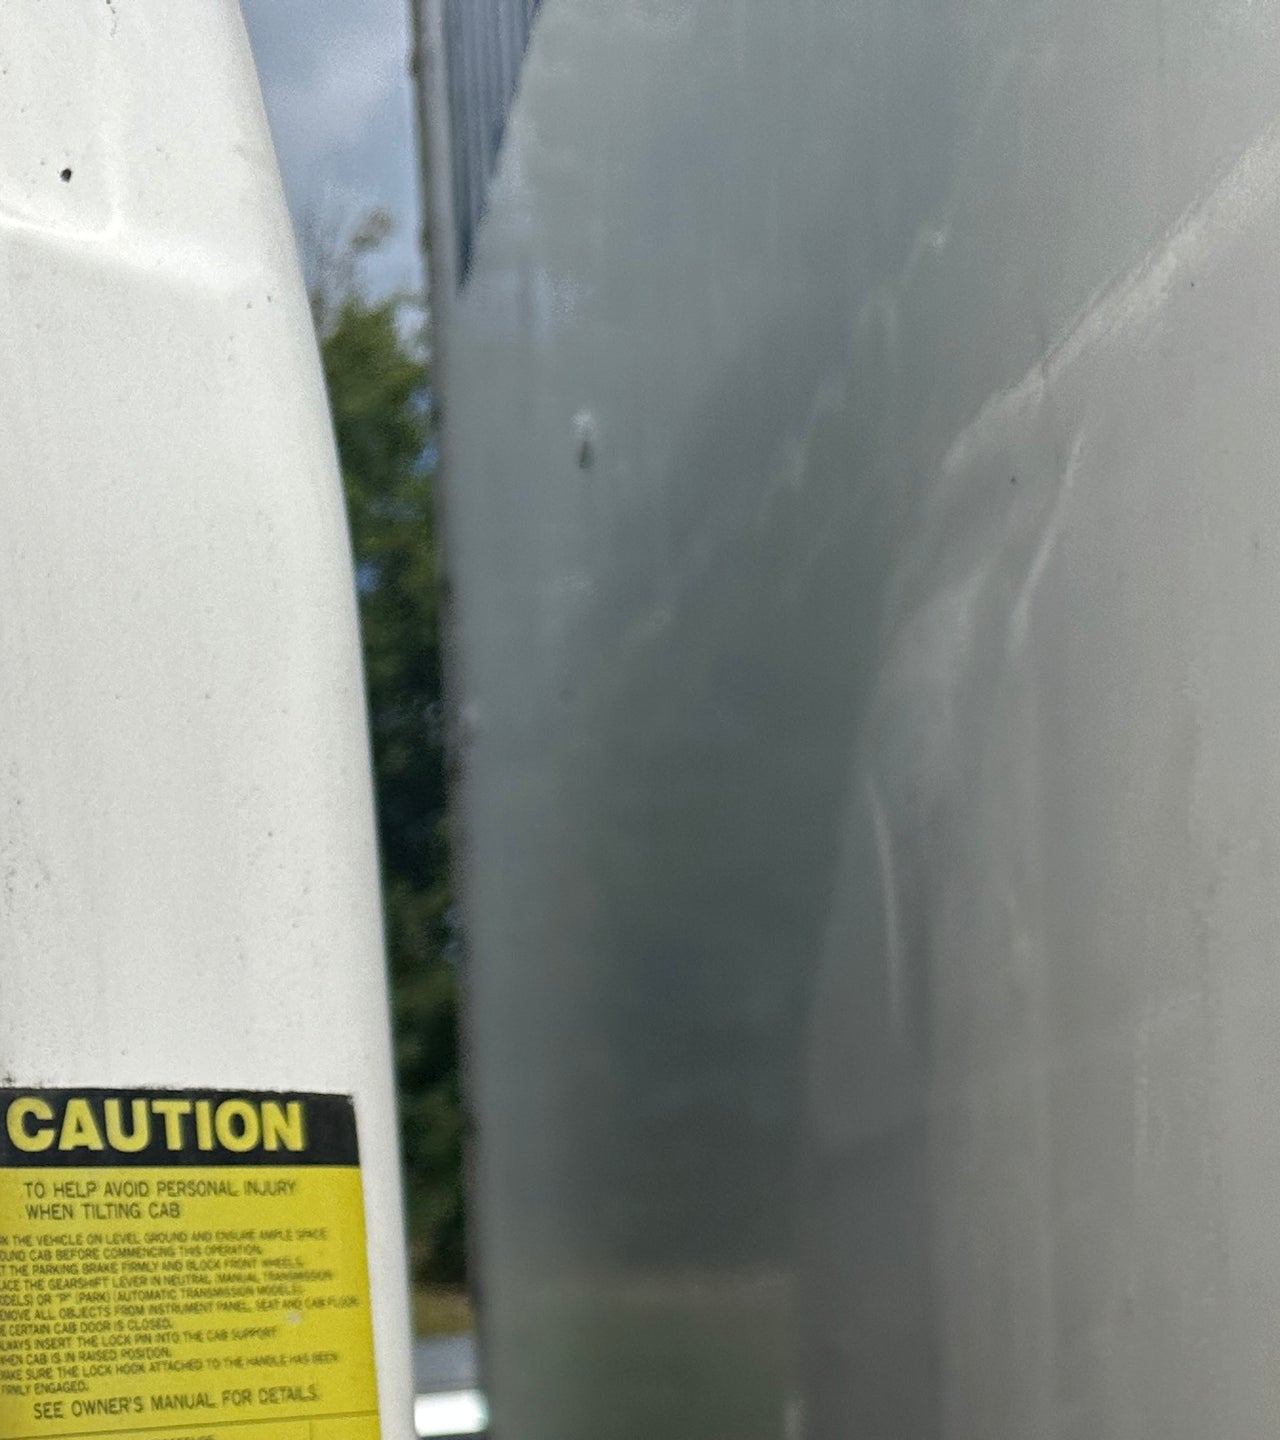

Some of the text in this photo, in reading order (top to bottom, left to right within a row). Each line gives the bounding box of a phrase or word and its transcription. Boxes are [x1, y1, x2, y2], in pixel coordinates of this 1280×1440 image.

[6, 1096, 308, 1153] CAUTION
[23, 1178, 297, 1199] TO HELP AVOID PERSONAL INJURY
[25, 1201, 181, 1220] WHEN TILTING CAB
[13, 1233, 33, 1247] THE
[36, 1232, 83, 1246] VEHICLE
[87, 1232, 102, 1246] ON
[105, 1231, 140, 1245] LEVEL
[144, 1230, 188, 1244] GROUND
[191, 1230, 213, 1243] AND
[29, 1248, 52, 1262] CAB
[55, 1247, 100, 1261] BEFORE
[103, 1246, 176, 1260] COMMENCING
[9, 1264, 29, 1277] THE
[32, 1262, 80, 1276] PARKING
[82, 1261, 119, 1275] BRAKE
[121, 1260, 159, 1274] FIRMLY
[162, 1259, 184, 1273] AND
[186, 1258, 221, 1272] BLOCK
[23, 1279, 45, 1292] THE
[48, 1276, 110, 1291] GEARSHIFT
[111, 1275, 148, 1289] LEVER
[151, 1275, 161, 1288] IN
[163, 1273, 211, 1287] NEUTRAL
[36, 1293, 52, 1307] OR
[180, 1284, 256, 1300] TRANSMISSION
[34, 1308, 56, 1322] ALL
[59, 1305, 111, 1320] OBJECTS
[114, 1304, 145, 1317] FROM
[147, 1301, 214, 1316] INSTRUMENT
[9, 1322, 51, 1337] CERTAIN
[53, 1321, 77, 1335] CAB
[79, 1319, 112, 1334] DOOR
[114, 1319, 125, 1332] IS
[34, 1336, 73, 1351] INSERT
[77, 1334, 99, 1349] THE
[101, 1333, 132, 1348] LOCK
[134, 1332, 153, 1345] PIN
[154, 1331, 180, 1344] INTO
[182, 1330, 204, 1343] THE
[206, 1328, 229, 1342] CAB
[0, 1353, 24, 1367] WHEN
[26, 1352, 49, 1366] CAB
[51, 1351, 62, 1364] IS
[64, 1350, 76, 1363] IN
[78, 1348, 117, 1362] RAISED
[25, 1366, 54, 1381] SURE
[56, 1364, 79, 1379] THE
[82, 1363, 113, 1378] LOCK
[115, 1361, 146, 1375] HOOK
[149, 1358, 204, 1373] ATTACHED
[206, 1357, 221, 1370] TO
[222, 1355, 244, 1370] THE
[33, 1379, 90, 1396] ENGAGED.
[33, 1400, 65, 1421] SEE
[70, 1395, 145, 1418] OWNER'S
[151, 1391, 218, 1412] MANUAL
[221, 1388, 253, 1408] FOR
